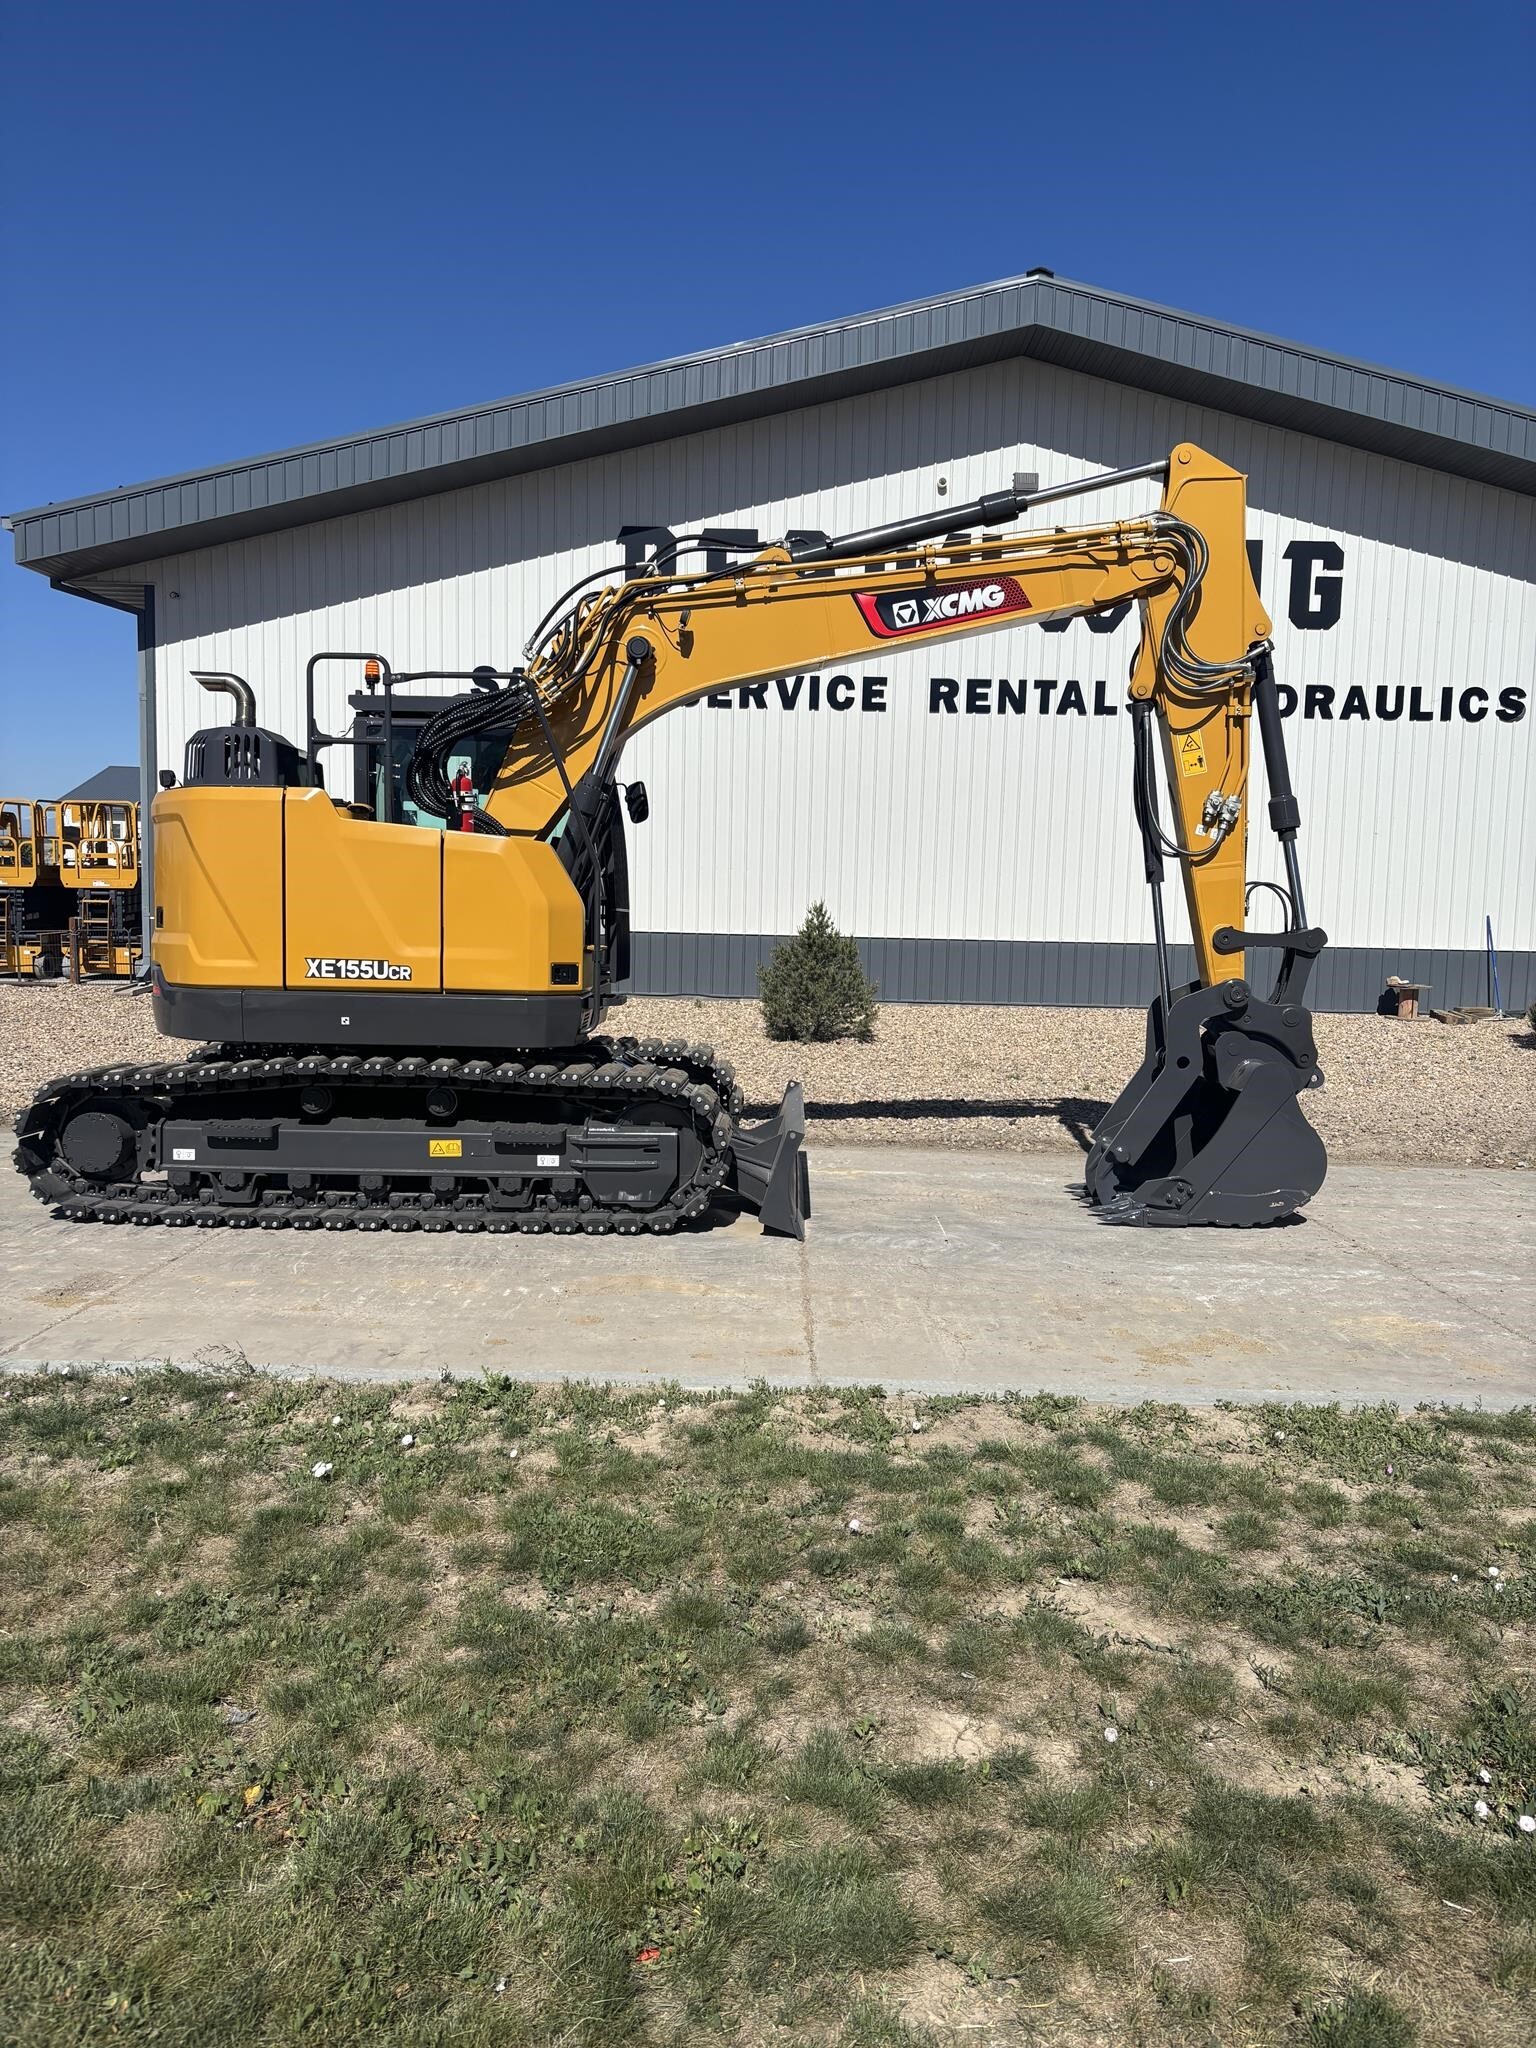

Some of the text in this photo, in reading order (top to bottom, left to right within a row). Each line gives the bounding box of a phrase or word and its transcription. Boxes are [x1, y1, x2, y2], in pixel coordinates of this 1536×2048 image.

[922, 584, 1005, 623] XCMG
[682, 675, 888, 713] ERVICE
[929, 677, 1155, 717] RENTAL
[305, 958, 412, 981] XE155UCR
